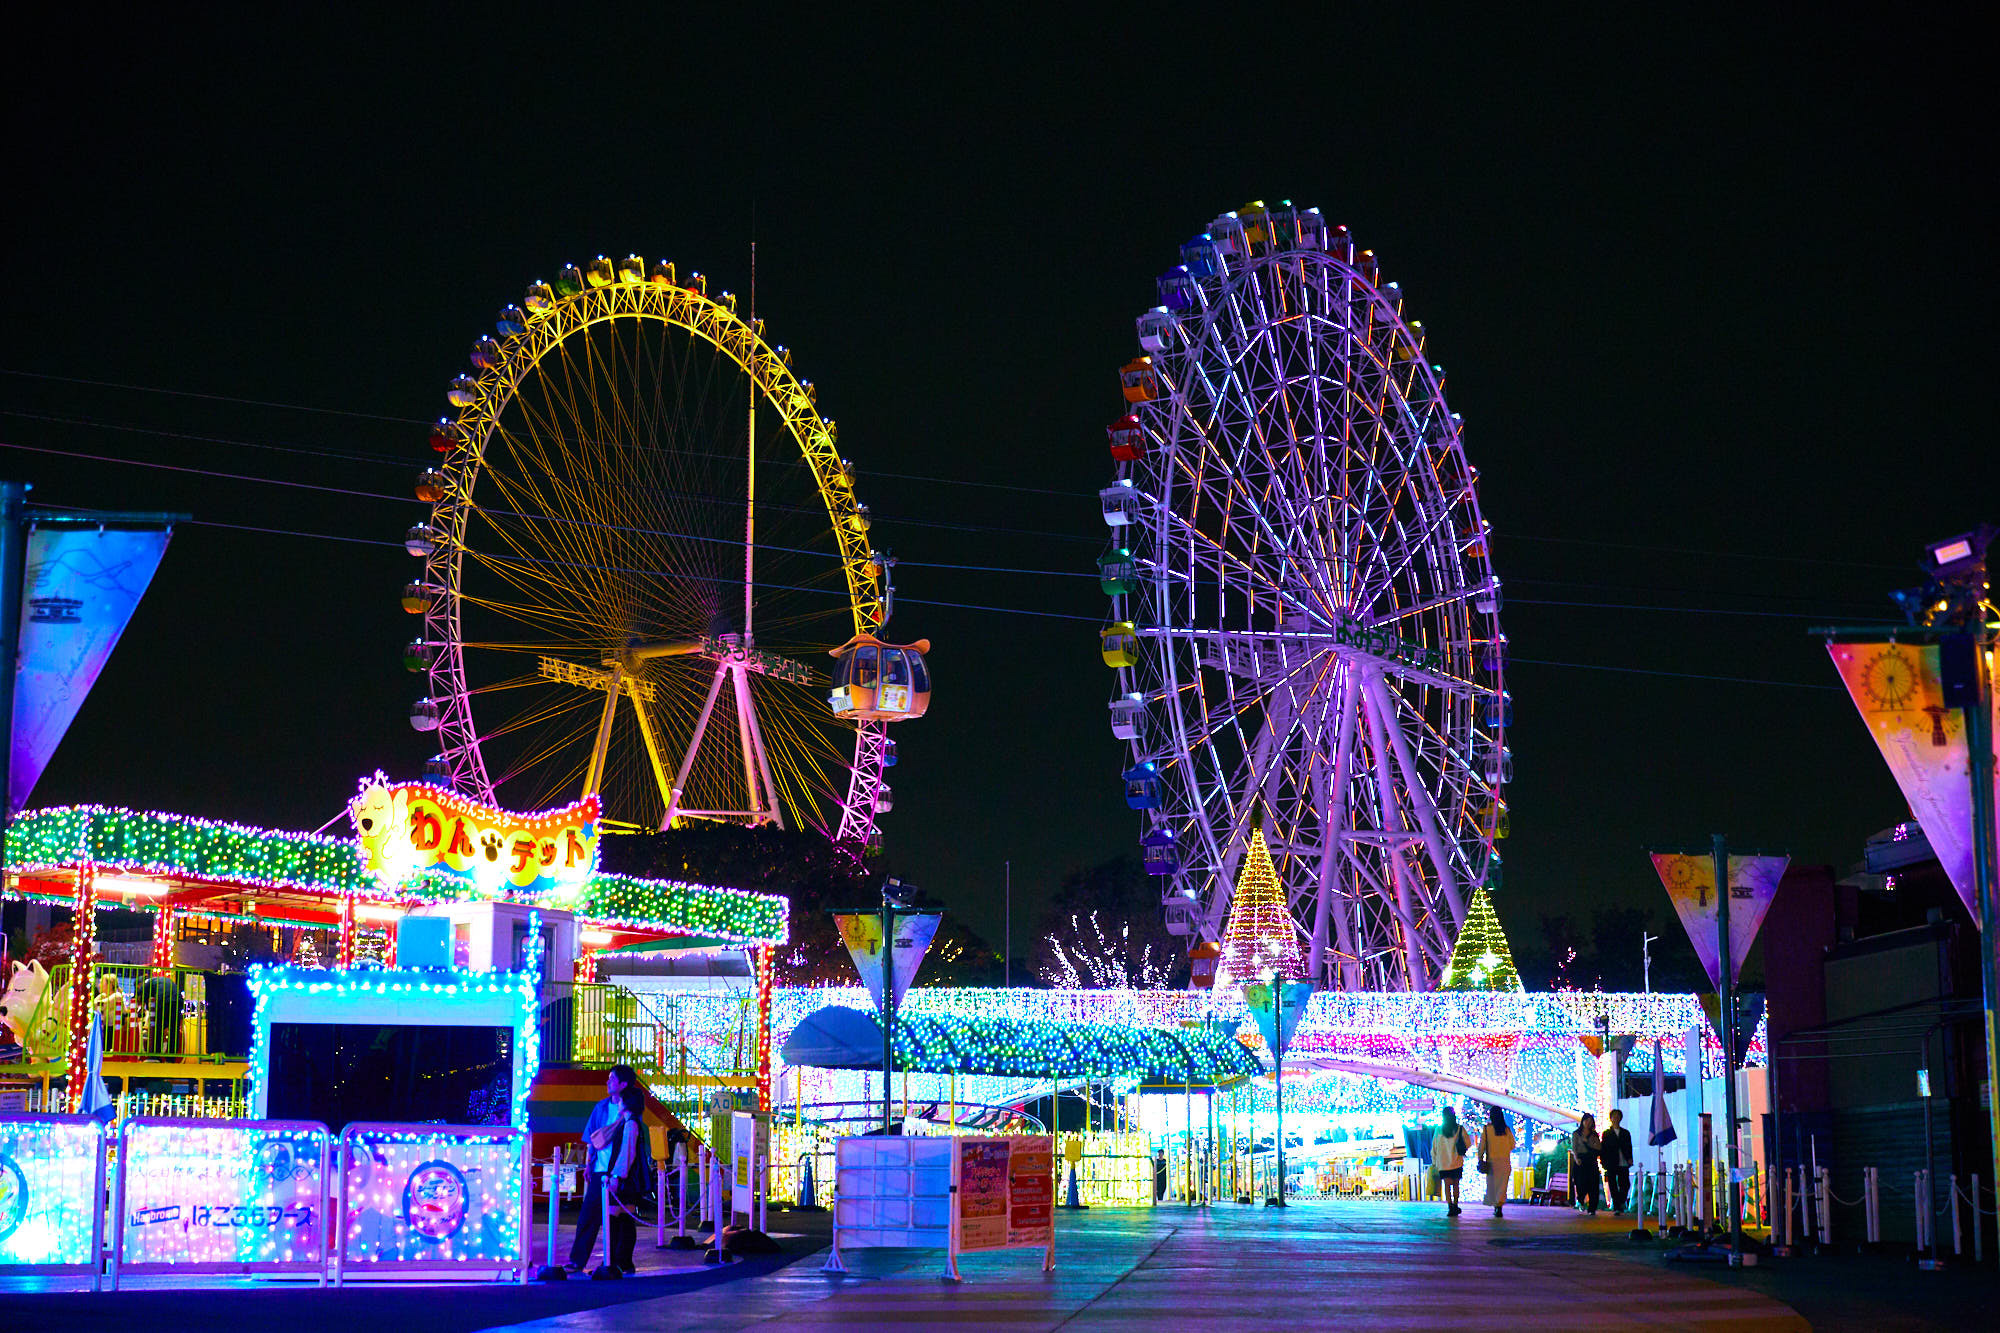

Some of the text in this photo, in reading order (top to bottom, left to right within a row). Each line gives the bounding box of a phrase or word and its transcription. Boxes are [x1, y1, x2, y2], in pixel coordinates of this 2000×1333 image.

[437, 794, 519, 827] わんわんコースター
[713, 1097, 730, 1109] 入口
[132, 1207, 179, 1225] Haoro
